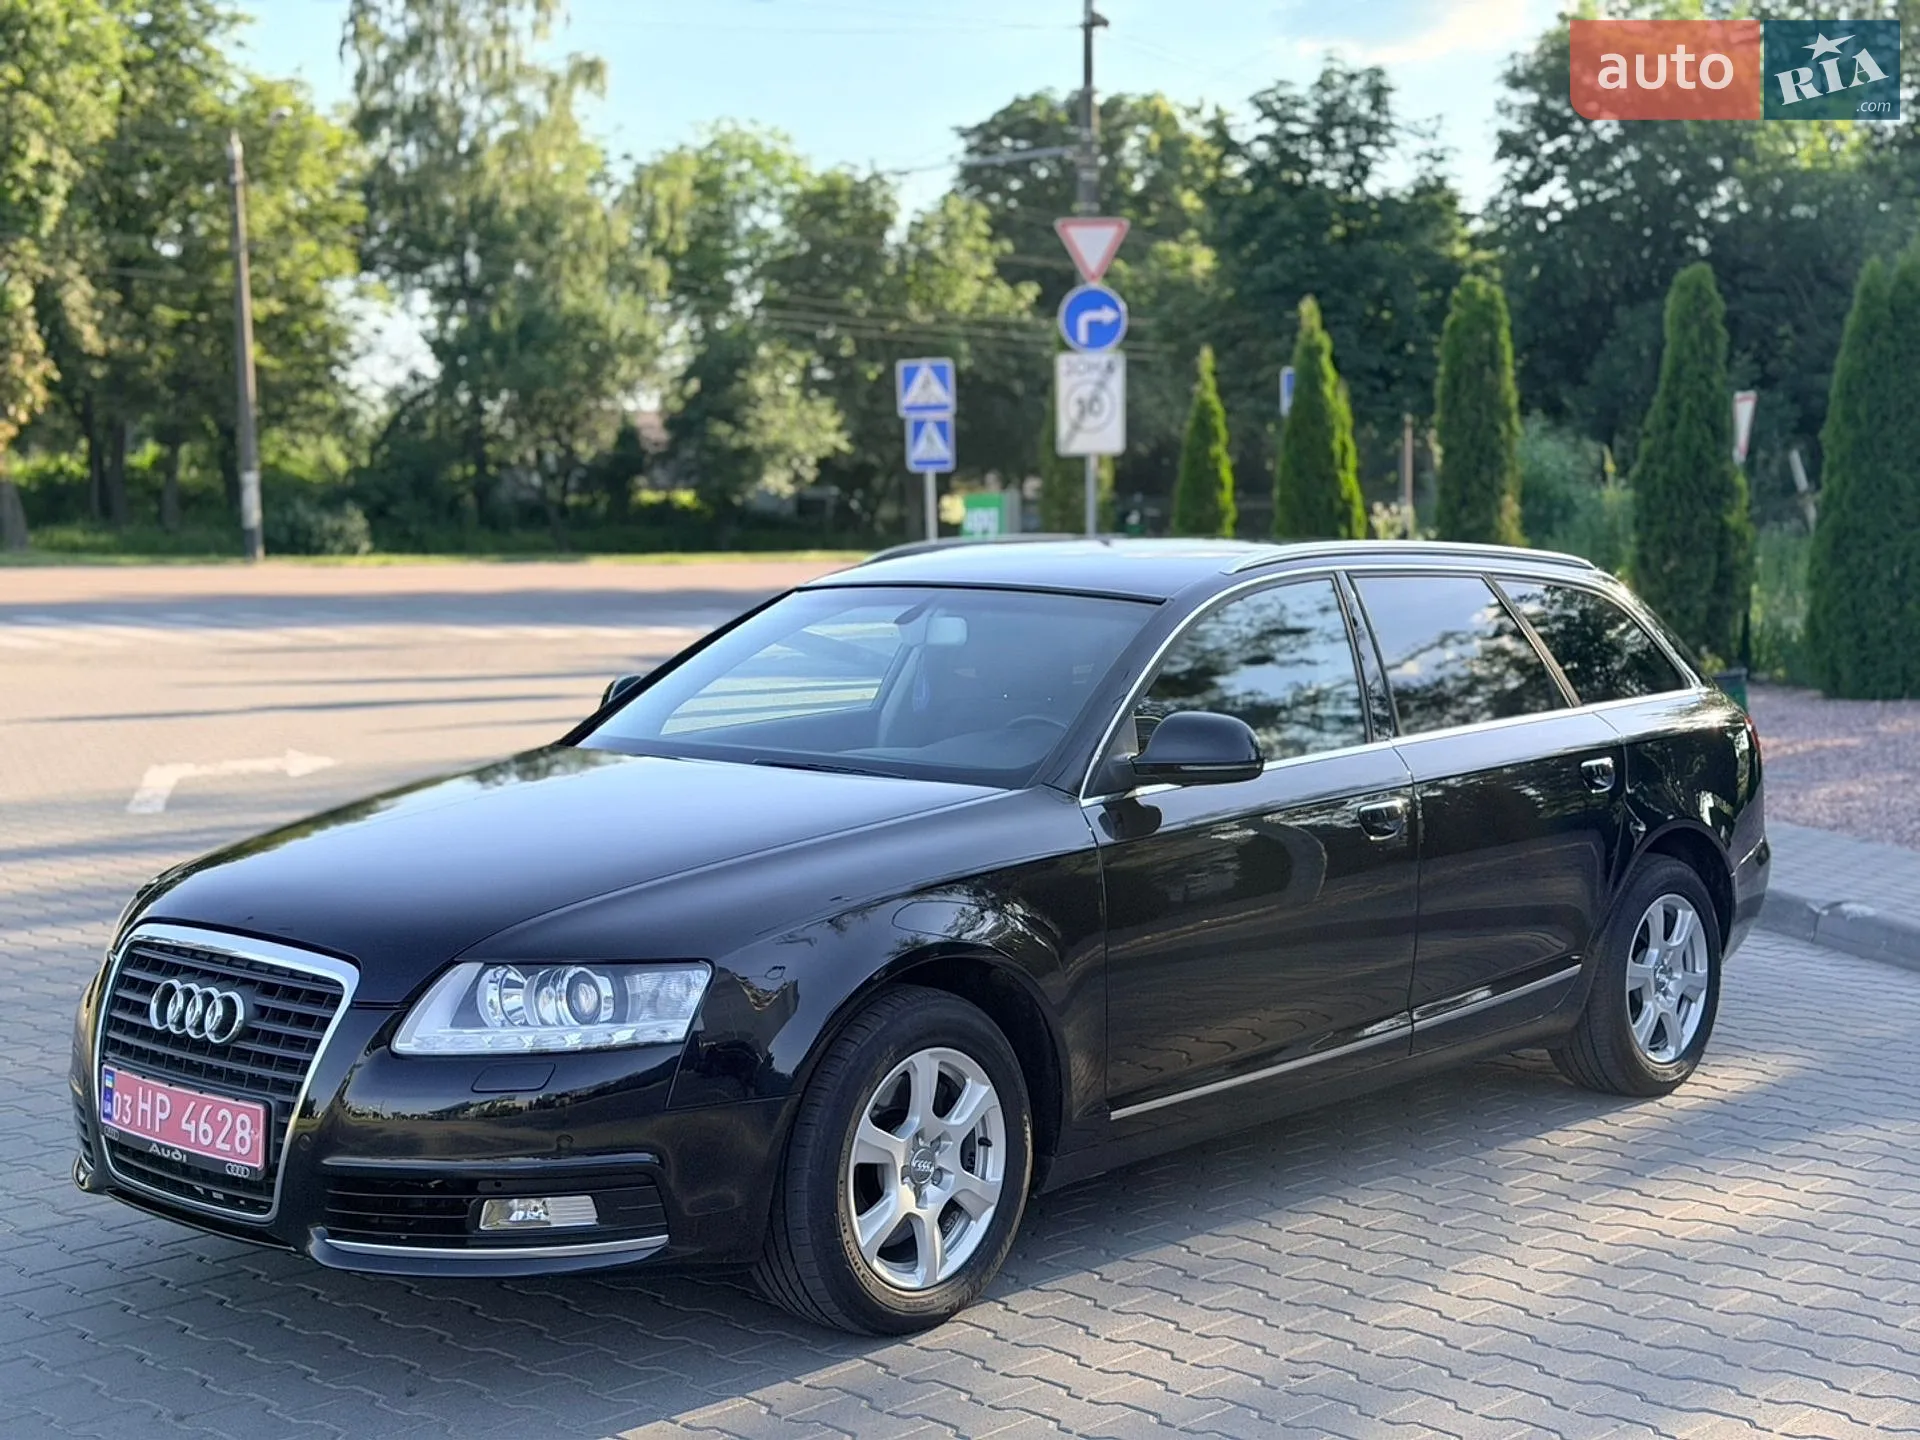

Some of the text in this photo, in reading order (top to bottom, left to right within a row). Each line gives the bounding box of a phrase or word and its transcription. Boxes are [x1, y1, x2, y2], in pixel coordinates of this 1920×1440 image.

[113, 1086, 252, 1155] 03 HP 4628
[149, 1143, 187, 1162] Audi
